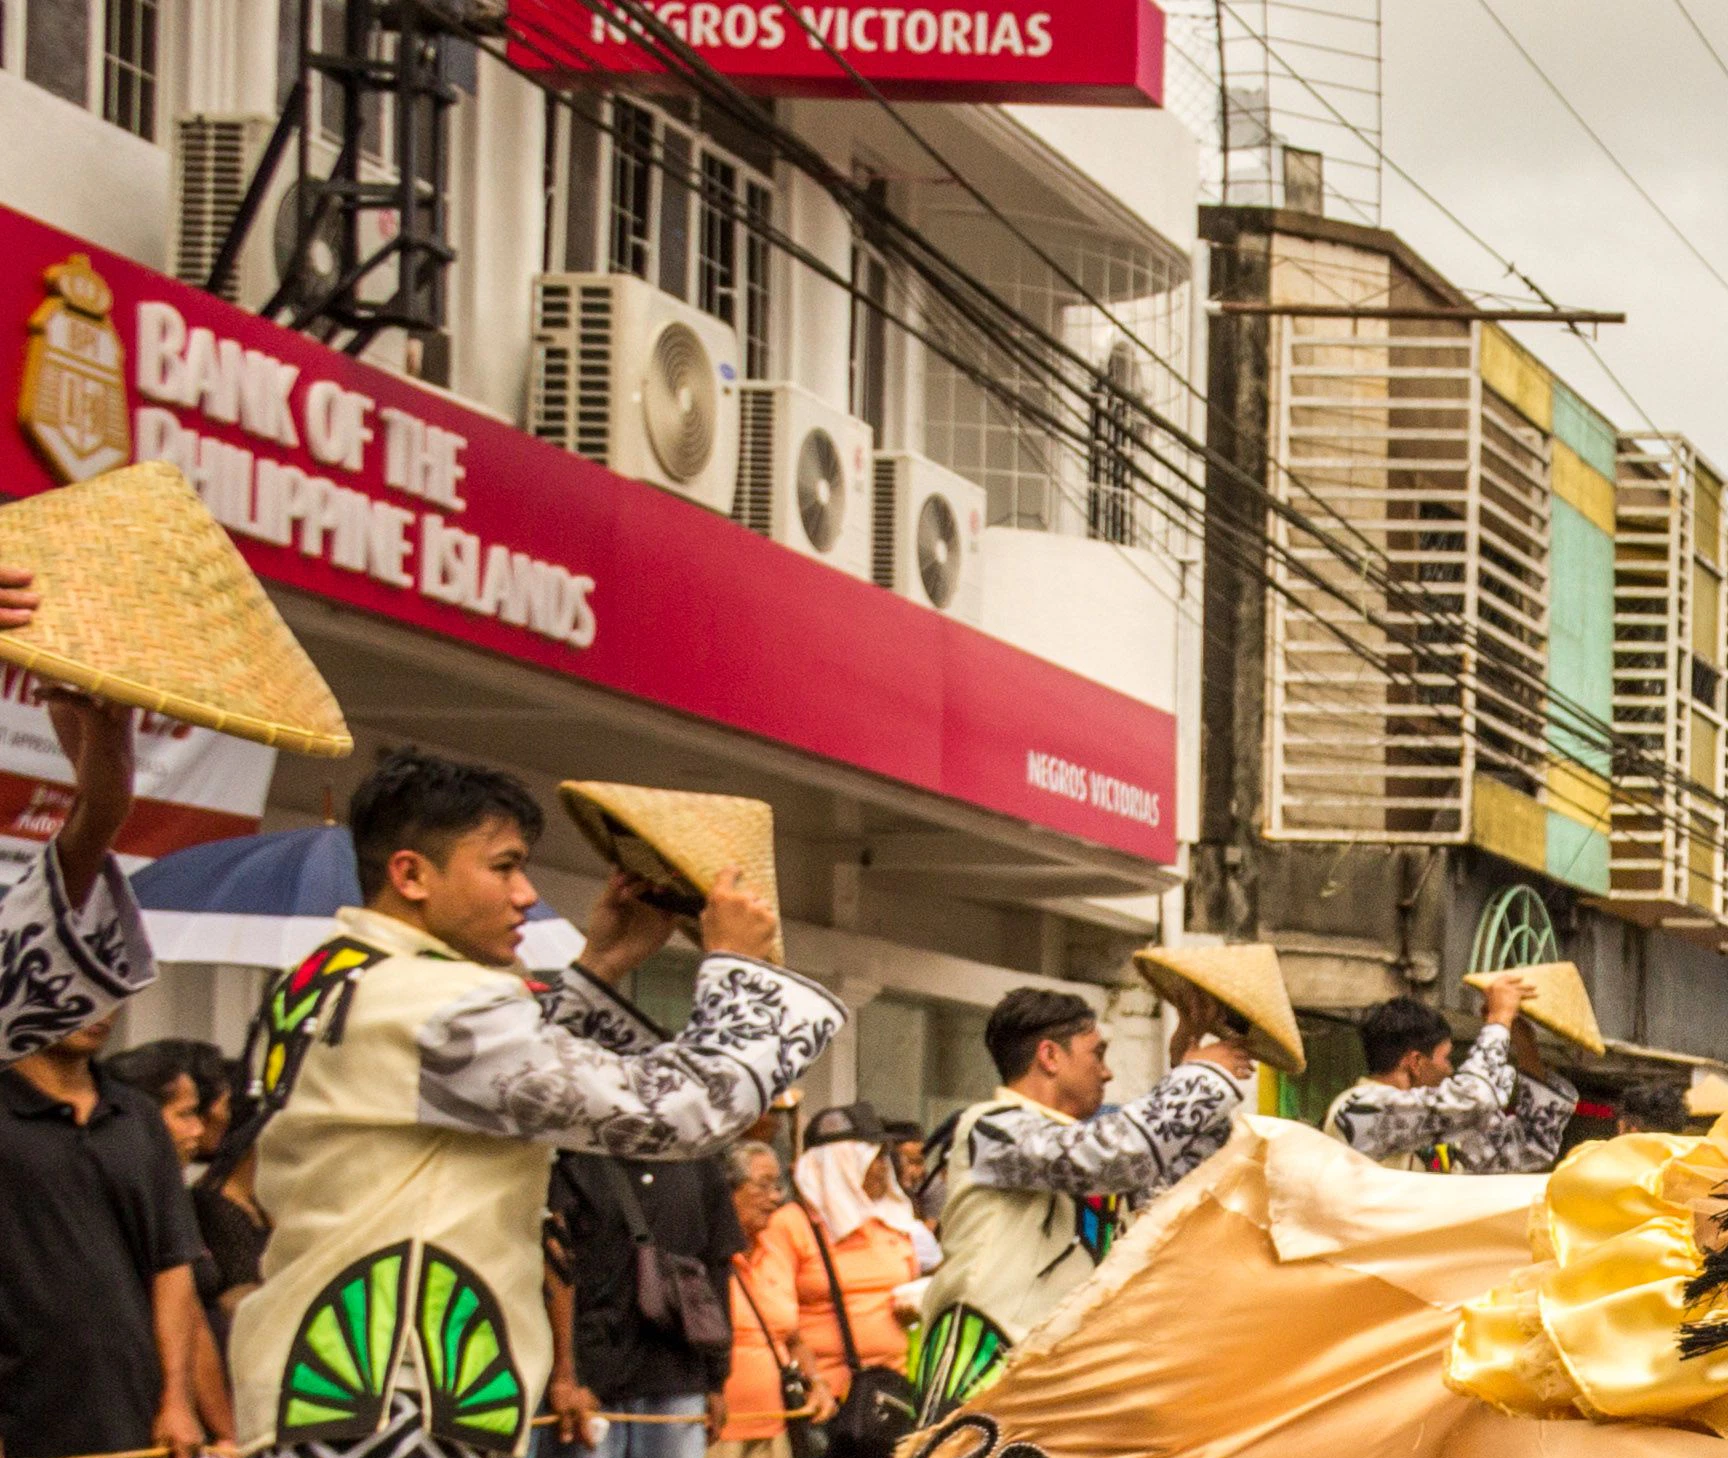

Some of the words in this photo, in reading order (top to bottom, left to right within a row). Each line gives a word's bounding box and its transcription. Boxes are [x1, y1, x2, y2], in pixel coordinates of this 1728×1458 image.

[801, 6, 1053, 57] VICTORIAS
[136, 301, 299, 447] BANK
[306, 380, 374, 472] OF
[380, 408, 467, 512] THE
[419, 513, 597, 649] ISLANDS
[1026, 750, 1088, 802] NEGROS
[1089, 770, 1160, 828] VICTORIAS
